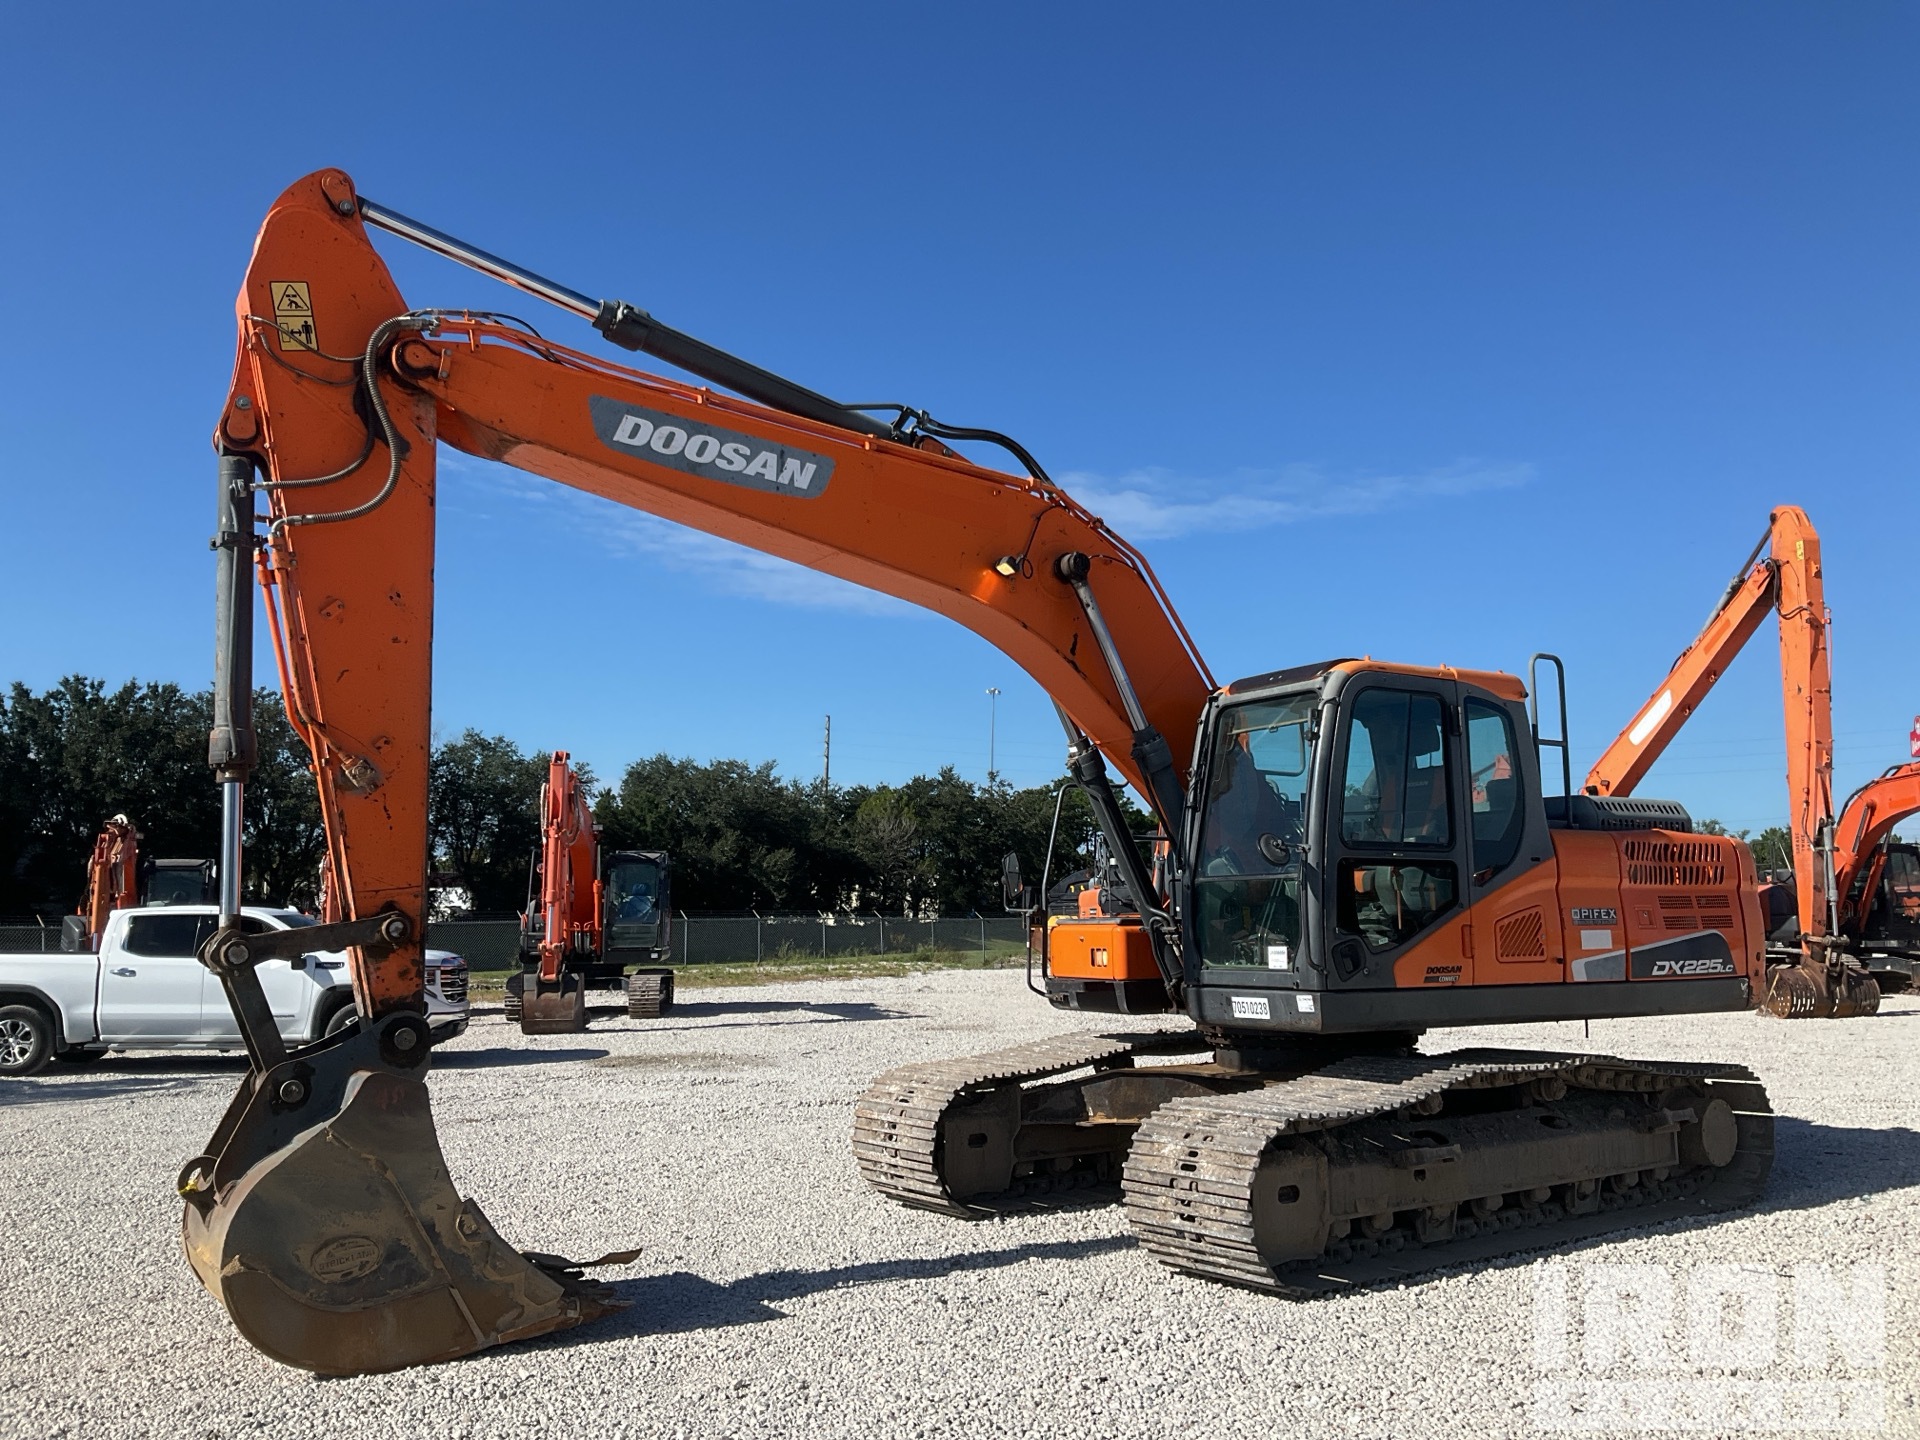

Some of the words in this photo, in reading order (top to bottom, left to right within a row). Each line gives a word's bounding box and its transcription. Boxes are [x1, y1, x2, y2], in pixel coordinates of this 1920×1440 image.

[612, 413, 817, 490] DOOSAN
[1426, 965, 1462, 974] DOOSAN
[1232, 1001, 1268, 1015] 70510238
